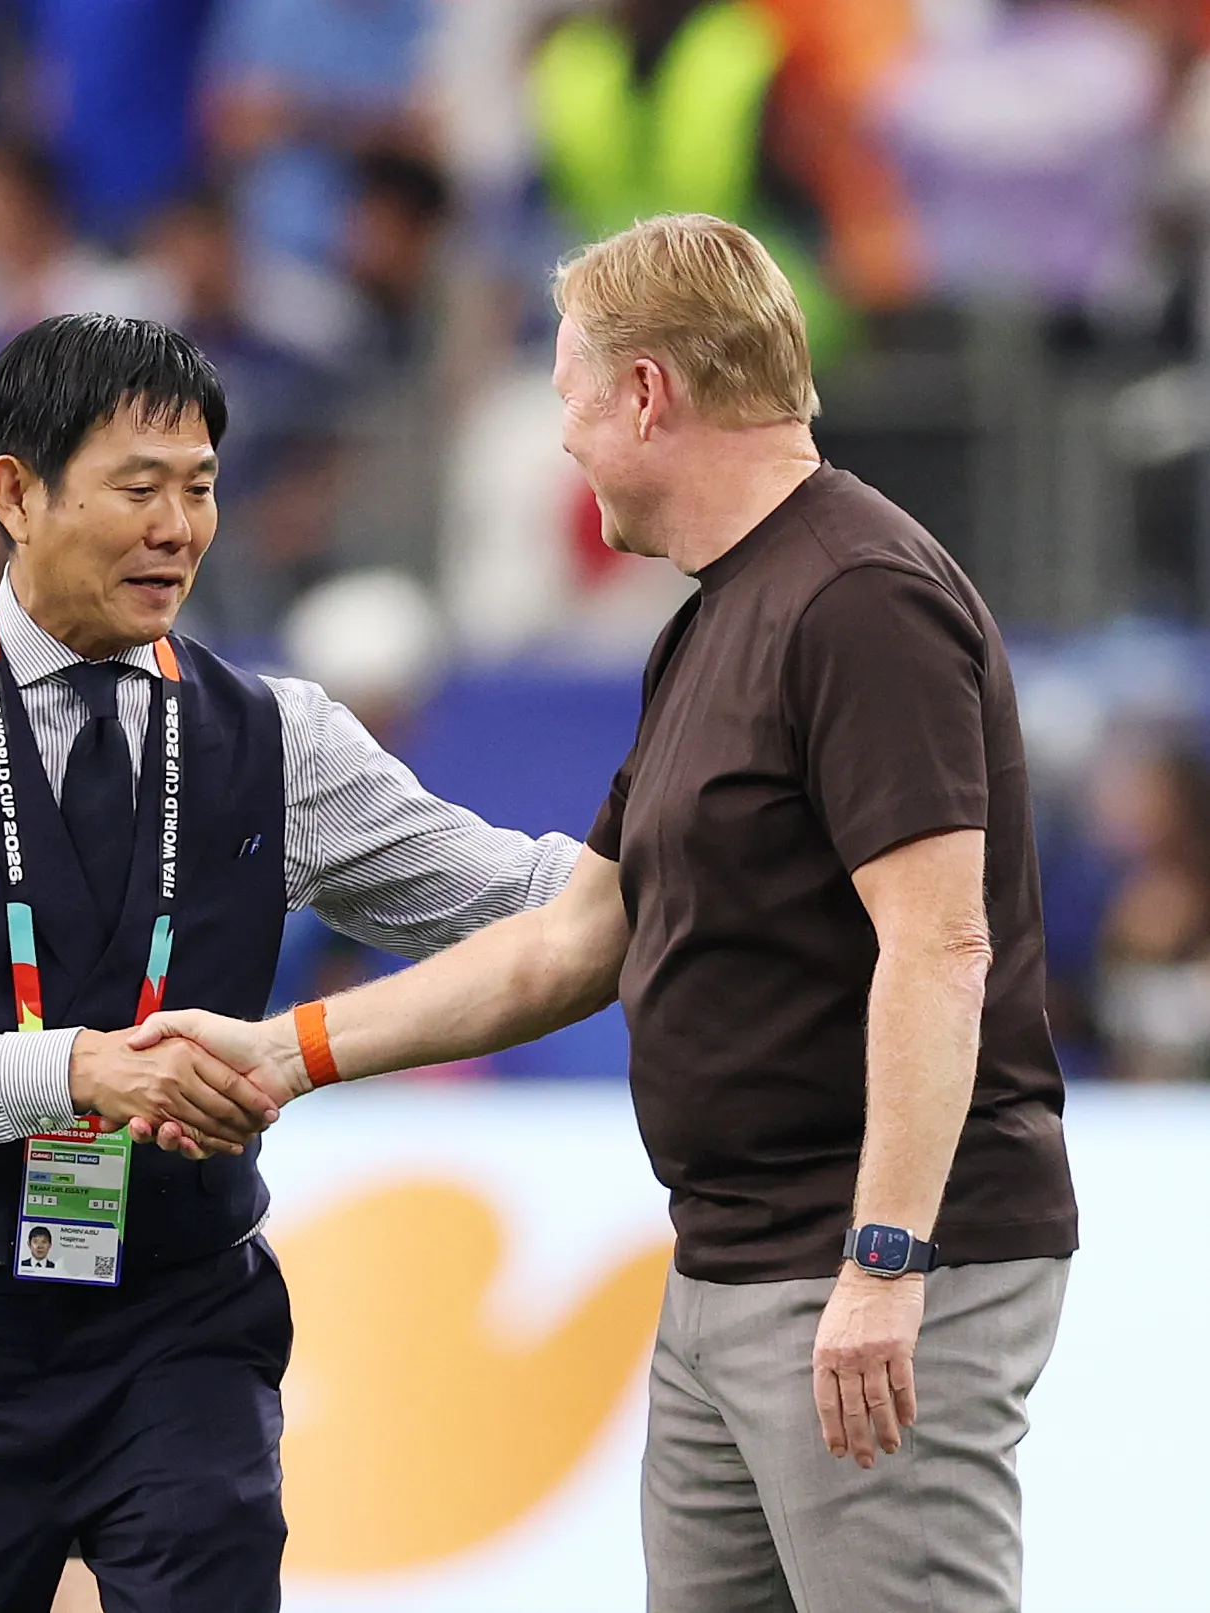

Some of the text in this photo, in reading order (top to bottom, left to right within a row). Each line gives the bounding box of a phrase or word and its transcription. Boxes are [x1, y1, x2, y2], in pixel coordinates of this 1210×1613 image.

[162, 698, 179, 898] FIFA WORLD CUP 2026
[3, 821, 23, 883] 2026
[53, 1129, 78, 1137] WORLD
[79, 1131, 95, 1139] CUP
